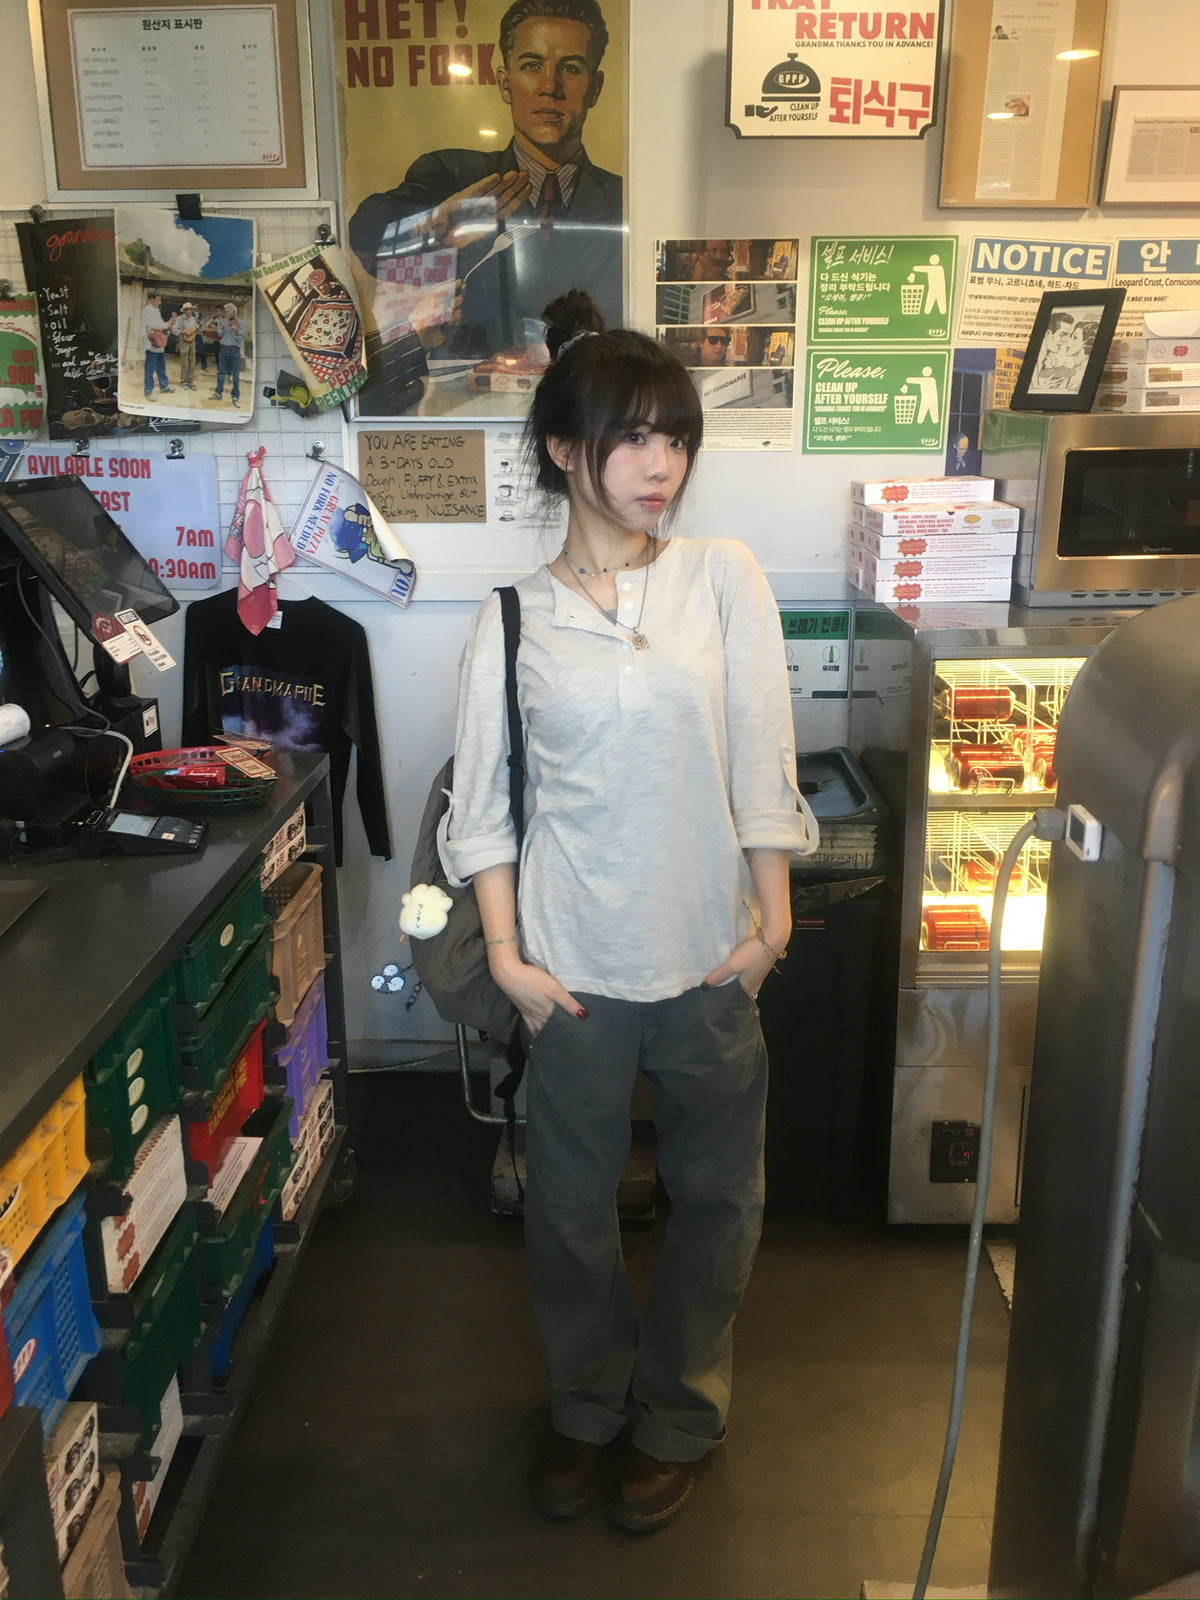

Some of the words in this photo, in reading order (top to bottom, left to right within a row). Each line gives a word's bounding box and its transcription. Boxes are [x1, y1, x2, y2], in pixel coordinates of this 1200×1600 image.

[142, 18, 171, 31] 원산지
[174, 18, 203, 30] 표시판
[795, 12, 935, 40] RETURN
[348, 46, 394, 88] NO
[408, 43, 499, 87] FORK
[778, 73, 806, 84] GPPP
[790, 103, 810, 111] CLEAN
[811, 102, 820, 110] UP
[829, 76, 931, 130] 퇴식구
[769, 114, 788, 122] AFTER
[788, 112, 819, 121] YOURSELF
[820, 241, 847, 270] 셀프
[848, 244, 895, 266] 서비스!
[976, 242, 1106, 276] NOTICE
[1140, 240, 1172, 273] 안
[262, 260, 290, 276] Garden
[820, 272, 829, 282] 다
[831, 272, 849, 282] 드신
[850, 272, 877, 282] 식기는
[969, 276, 985, 285] 표범
[1115, 278, 1143, 288] Leopard
[1144, 278, 1164, 288] Crust,
[42, 285, 69, 302] Yeast
[820, 283, 837, 292] 정리
[840, 282, 891, 292] 부탁드립니다
[47, 303, 69, 316] Salt
[818, 317, 836, 325] CLEAN
[836, 317, 844, 325] UP
[845, 317, 862, 325] AFTER
[862, 317, 890, 325] YOURSELF
[815, 382, 843, 393] CLEAN
[845, 382, 858, 393] UP
[815, 393, 841, 405] AFTER
[843, 393, 889, 405] YOURSELF
[364, 434, 389, 451] YOU
[393, 433, 416, 451] ARE
[421, 434, 466, 450] EATING
[27, 454, 104, 477] AVILABLE
[109, 458, 151, 479] SOON
[365, 456, 375, 469] A
[380, 456, 423, 469] 3-DAYS
[428, 457, 454, 469] OLD
[324, 472, 337, 487] NO
[312, 486, 331, 512] FORK
[322, 494, 339, 526] GREAT
[426, 504, 485, 518] NUISANCE
[296, 514, 319, 551] NEEDED
[305, 526, 326, 554] PIZZA
[787, 617, 819, 635] 쓰레기
